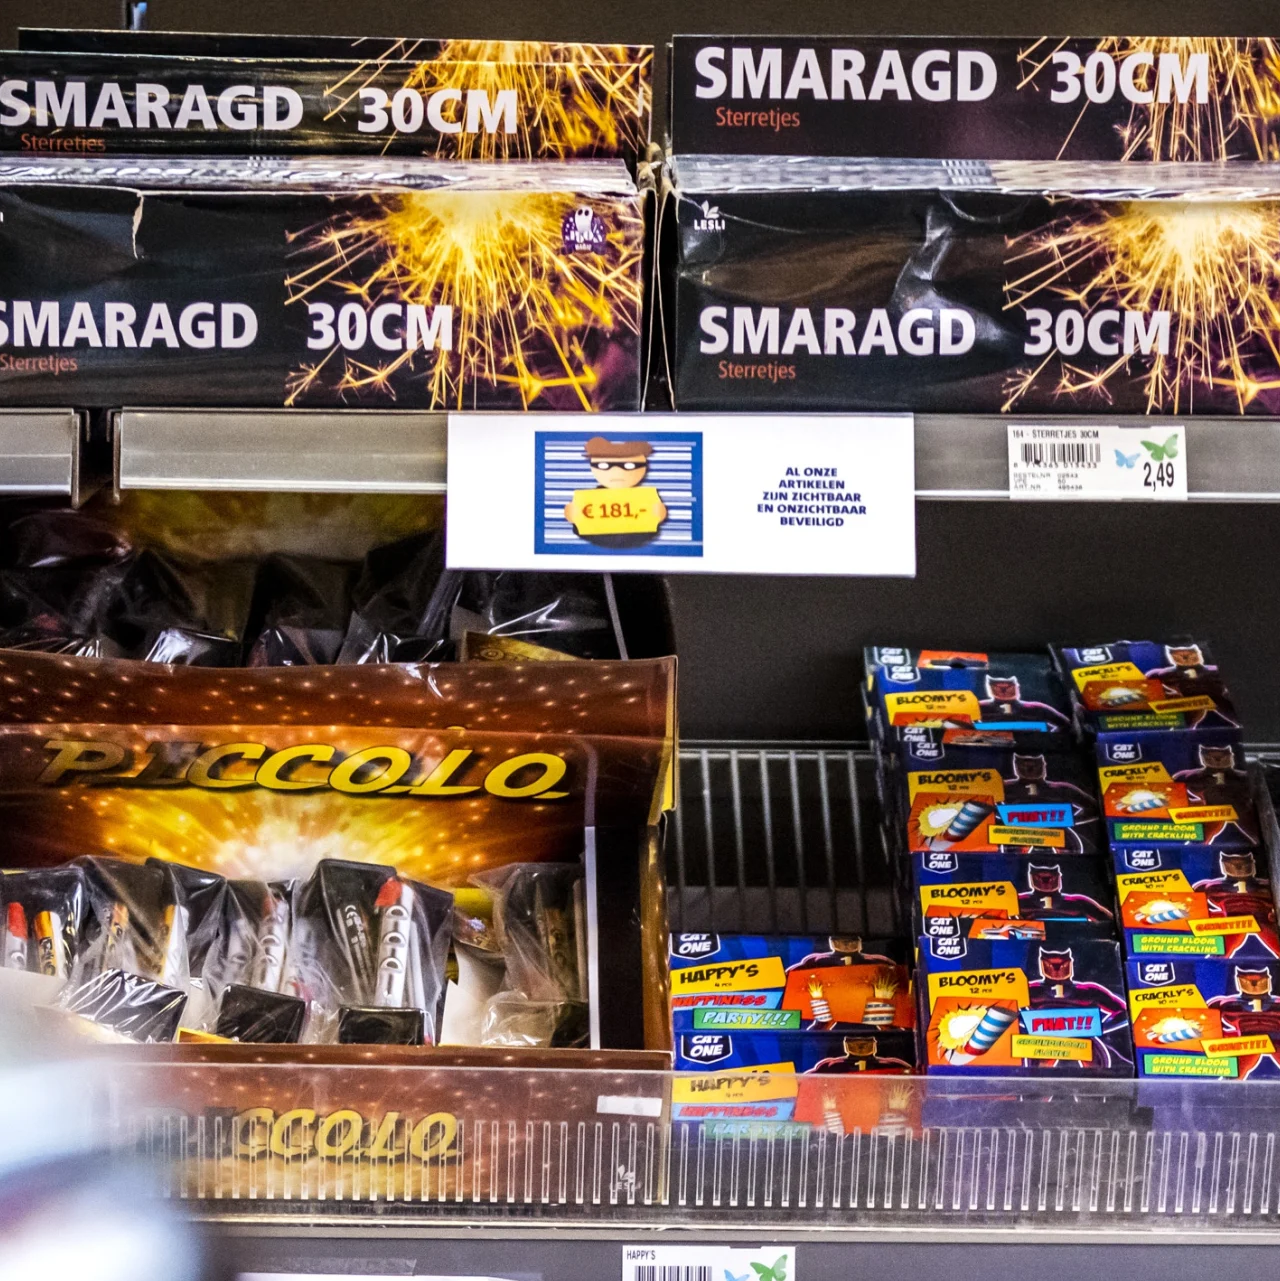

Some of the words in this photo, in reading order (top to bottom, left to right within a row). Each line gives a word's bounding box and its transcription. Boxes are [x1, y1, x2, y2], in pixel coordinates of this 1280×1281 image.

[695, 47, 997, 102] SMARAGD
[1051, 52, 1210, 104] 30CM
[0, 80, 304, 131] SMARAGD
[357, 87, 518, 135] 30CM
[716, 107, 801, 130] Sterretjes
[307, 303, 453, 351] 30CM
[700, 307, 976, 356] SMARAGD
[1024, 310, 1171, 356] 30CM
[0, 355, 78, 374] Sterretjes
[719, 361, 796, 382] Sterretjes
[1013, 430, 1023, 438] 164
[1032, 430, 1077, 439] STERRETJES
[1080, 430, 1099, 439] 30CM
[785, 467, 800, 477] AL
[804, 467, 837, 477] ONZE
[1143, 462, 1175, 492] 2,49
[779, 479, 845, 489] ARTIKELEN
[763, 491, 788, 502] ZIJN
[792, 491, 861, 502] ZICHTBAAR
[582, 504, 594, 518] €
[600, 503, 647, 520] 181,-
[757, 504, 773, 514] EN
[777, 504, 867, 515] ONZICHTBAAR
[780, 516, 844, 527] BEVEILIGD
[40, 738, 570, 799] PICCOLO
[930, 884, 1006, 902] BLOOMY'S
[680, 963, 760, 984] HAPPY'S
[1144, 972, 1169, 982] ONE
[1145, 964, 1167, 973] CAT
[938, 973, 1017, 988] BLOOMY'S
[1134, 989, 1194, 1002] CRACKLY'S
[700, 1010, 790, 1027] PARTY!!!
[1031, 1016, 1094, 1032] PHAT!!
[627, 1250, 656, 1260] HAPPY'S
